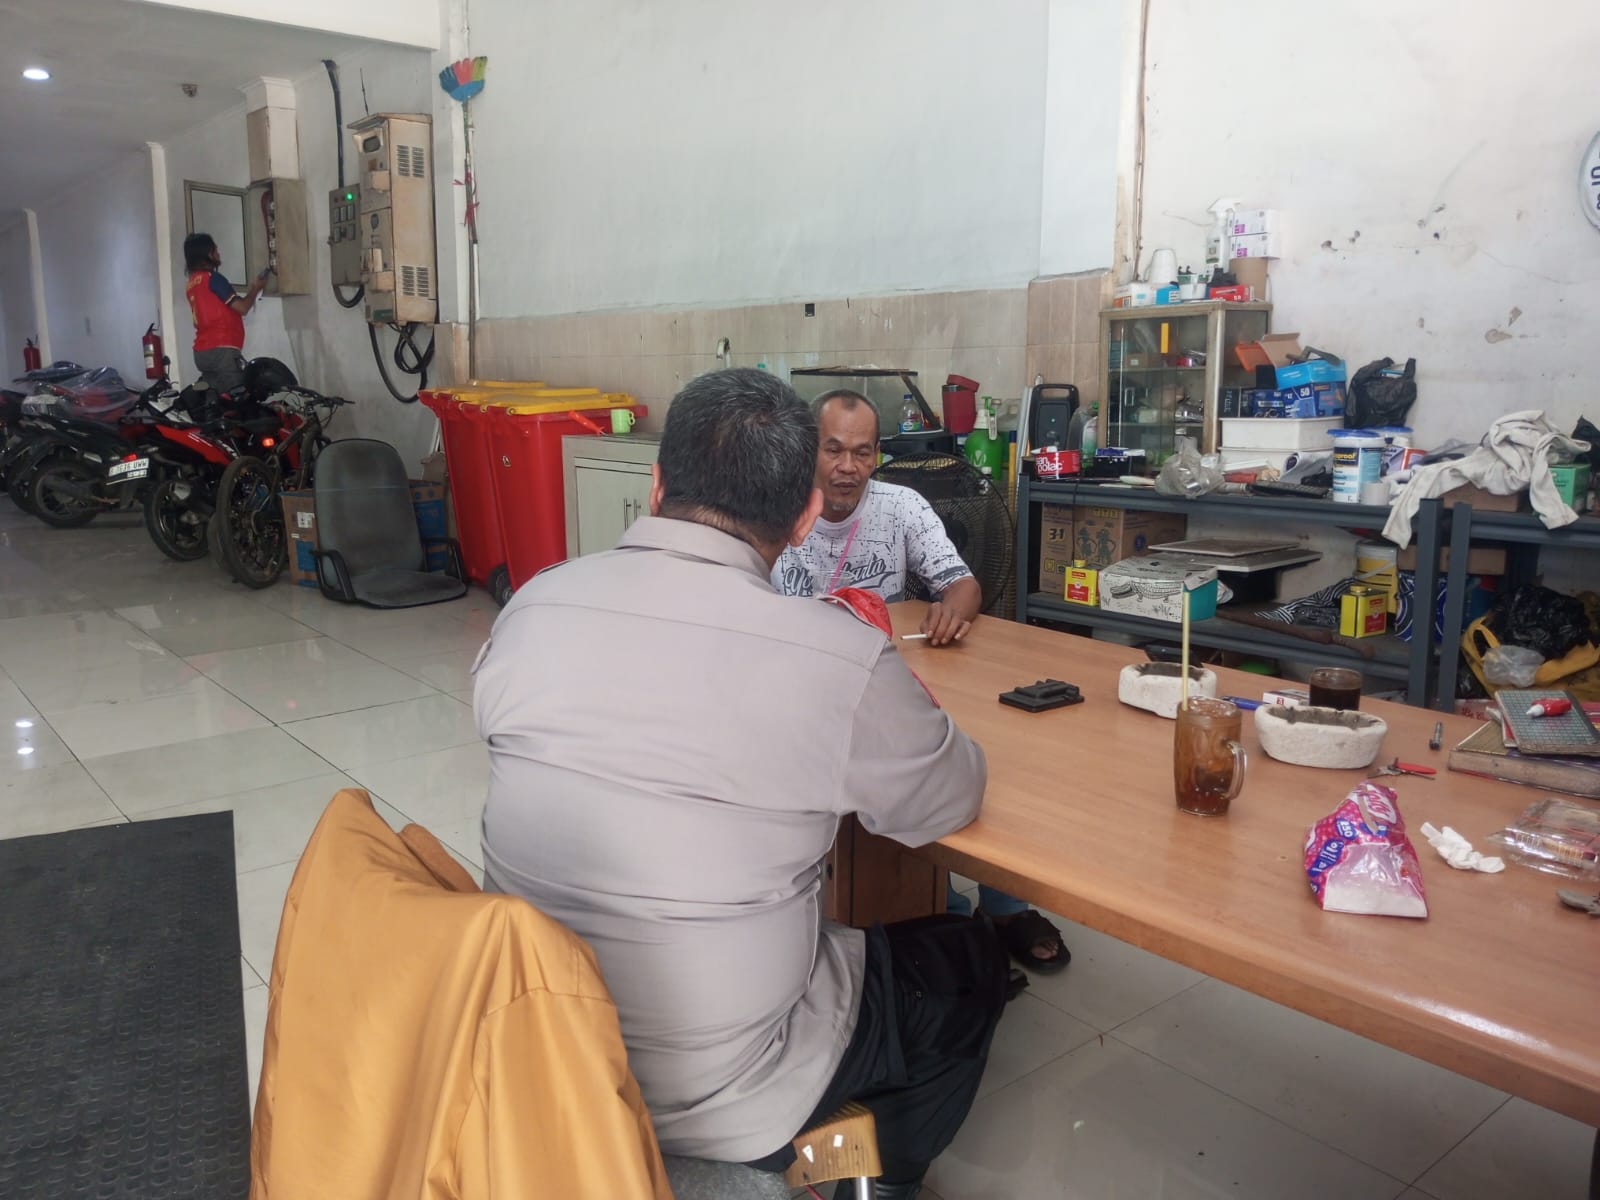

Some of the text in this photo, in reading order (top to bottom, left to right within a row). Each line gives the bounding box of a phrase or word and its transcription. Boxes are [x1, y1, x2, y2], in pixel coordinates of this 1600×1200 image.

[1300, 388, 1310, 397] 50
[1038, 461, 1063, 473] polac
[1340, 820, 1353, 838] 250
